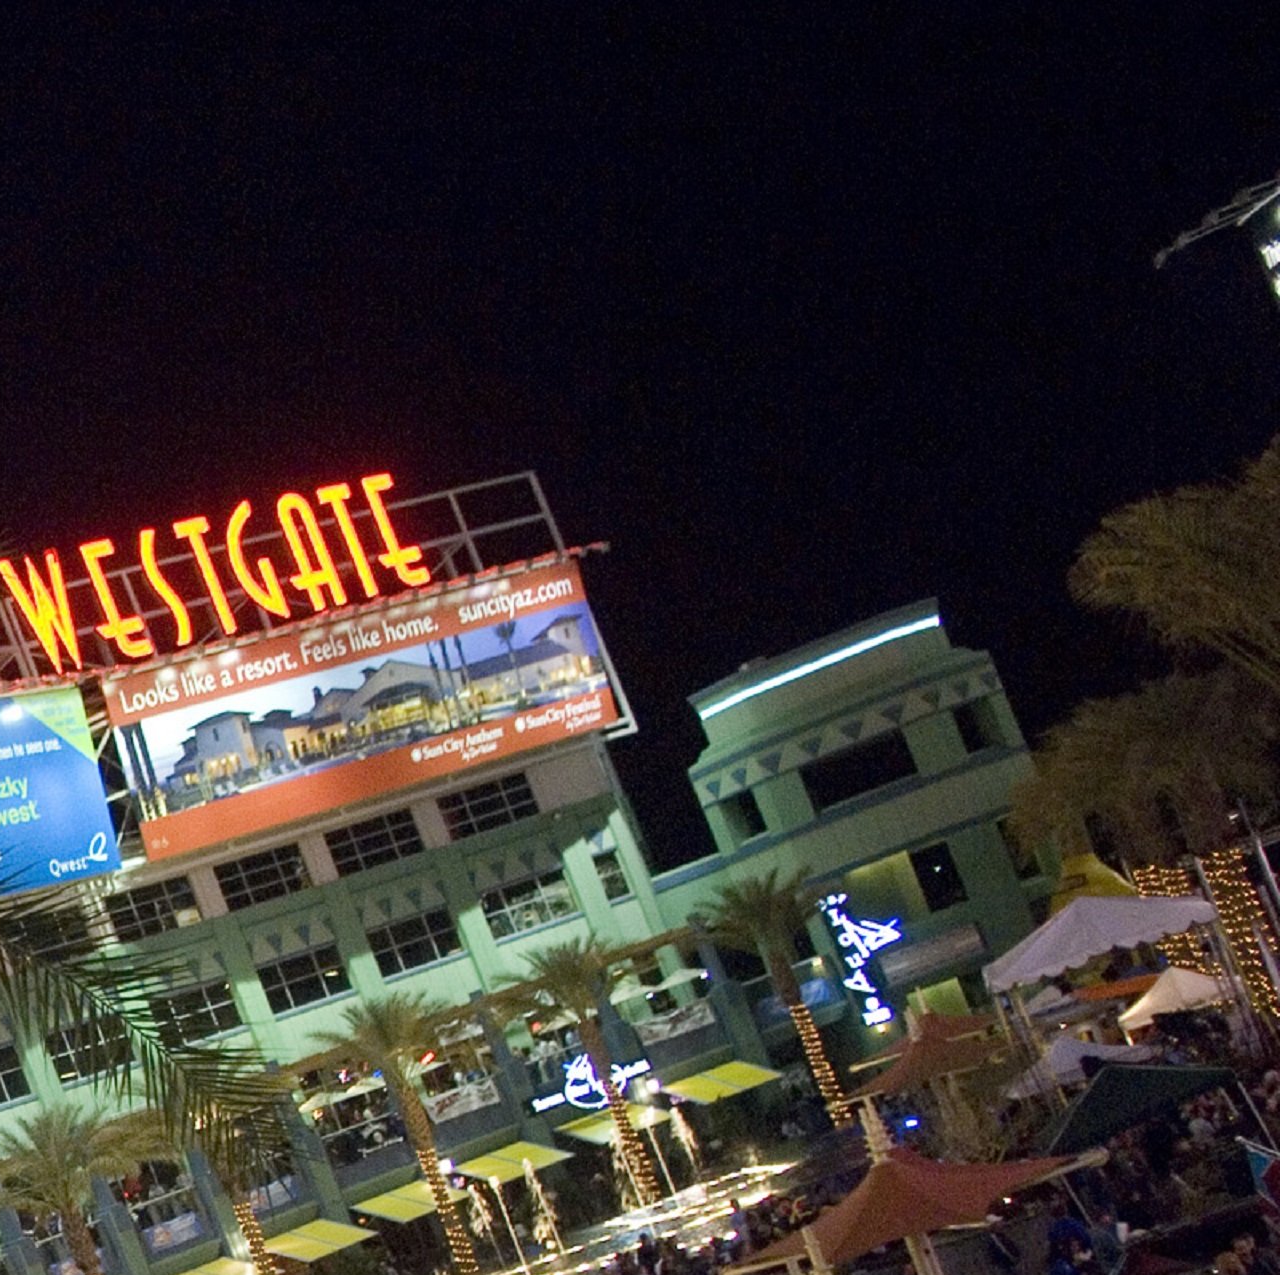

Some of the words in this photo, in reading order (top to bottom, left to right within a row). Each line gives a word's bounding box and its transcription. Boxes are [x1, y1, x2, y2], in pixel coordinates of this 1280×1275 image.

[458, 577, 573, 625] suncityaz.com
[118, 680, 179, 715] Looks
[181, 667, 217, 699] like
[220, 670, 236, 688] a
[236, 651, 298, 683] resort.
[299, 634, 346, 667] Feels
[348, 620, 382, 652] like
[383, 613, 440, 645] home.
[49, 859, 88, 878] Qwest
